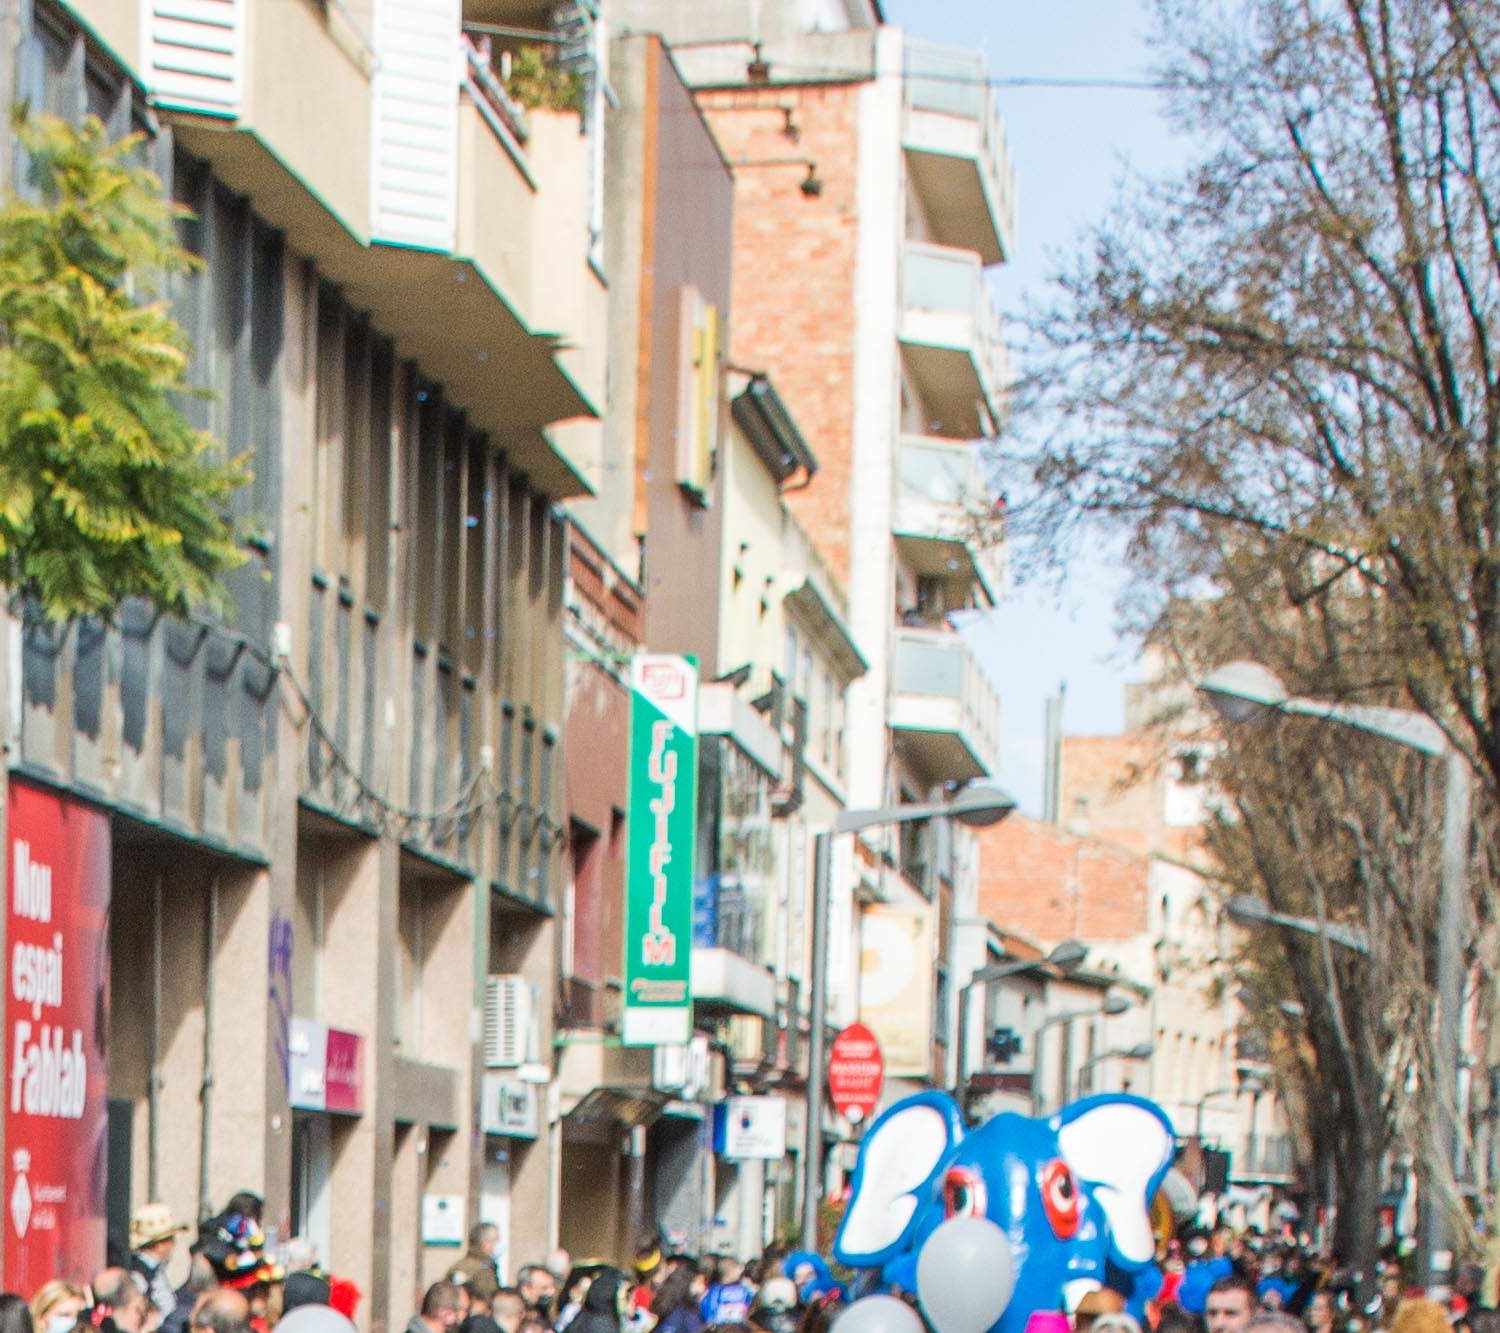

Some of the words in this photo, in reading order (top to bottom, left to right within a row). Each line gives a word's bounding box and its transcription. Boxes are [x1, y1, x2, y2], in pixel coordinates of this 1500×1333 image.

[11, 838, 52, 922] Nou
[11, 932, 63, 1020] espai
[10, 1018, 86, 1120] Fablab
